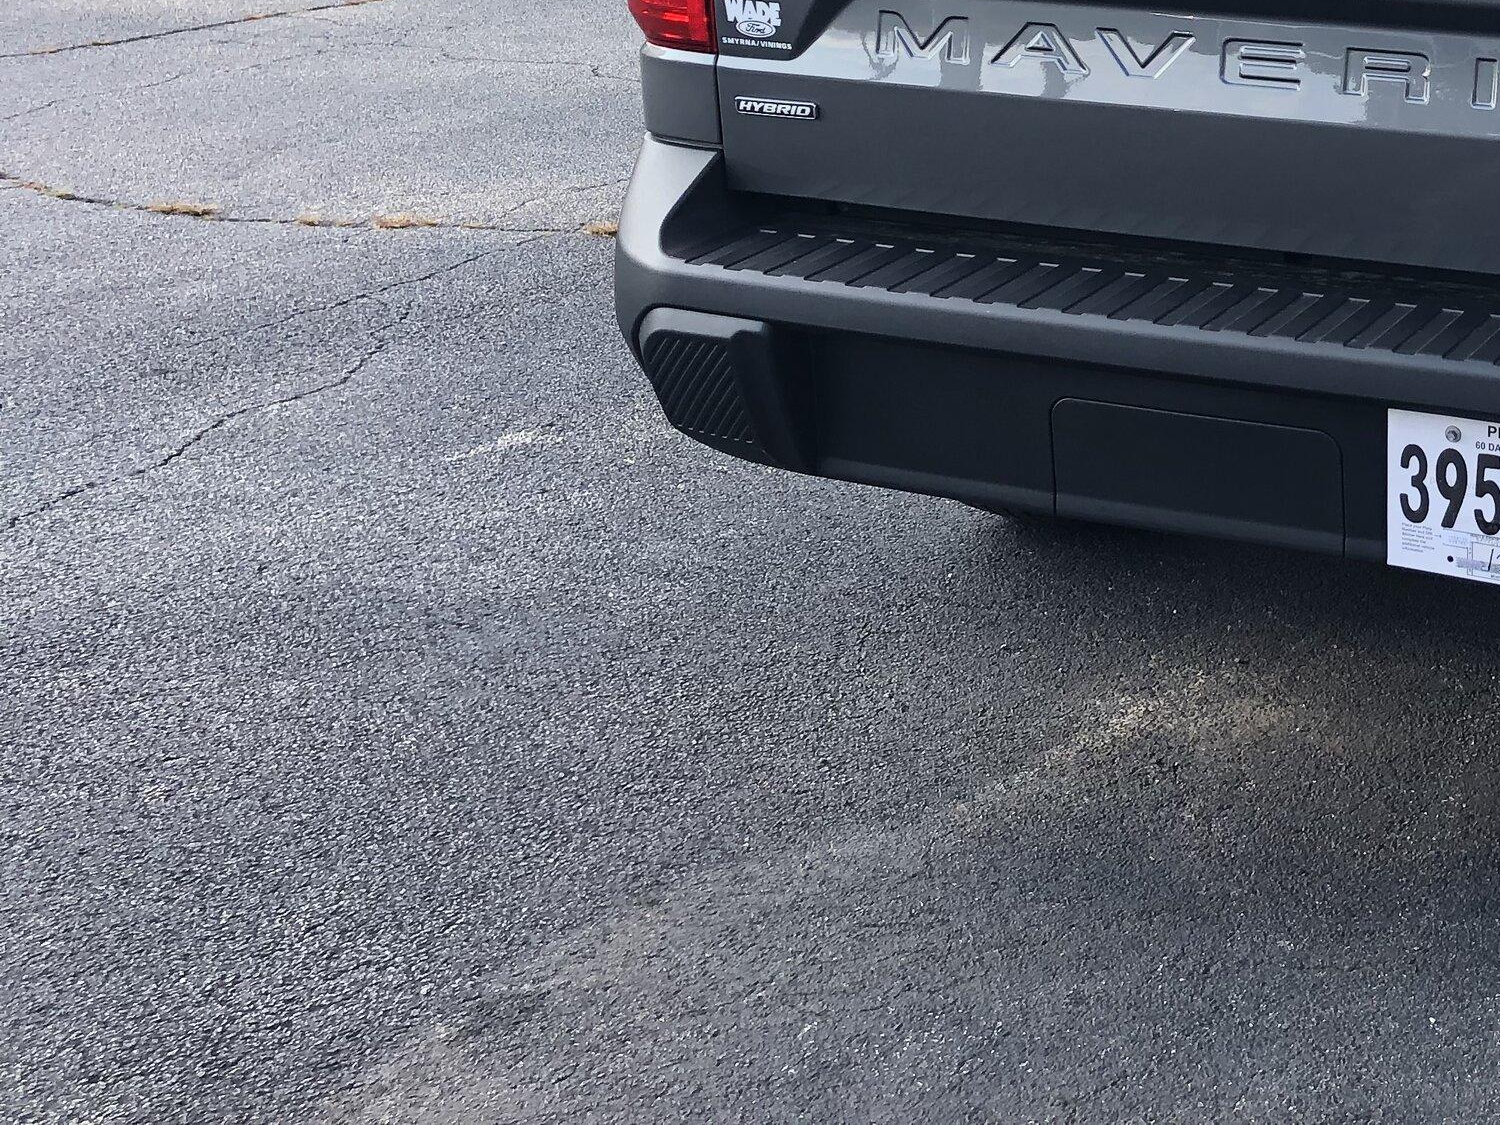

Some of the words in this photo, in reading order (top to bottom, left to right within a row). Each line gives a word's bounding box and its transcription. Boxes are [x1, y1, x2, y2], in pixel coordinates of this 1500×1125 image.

[744, 22, 768, 34] Ford
[738, 100, 811, 117] HYBRID
[1475, 440, 1486, 450] 60
